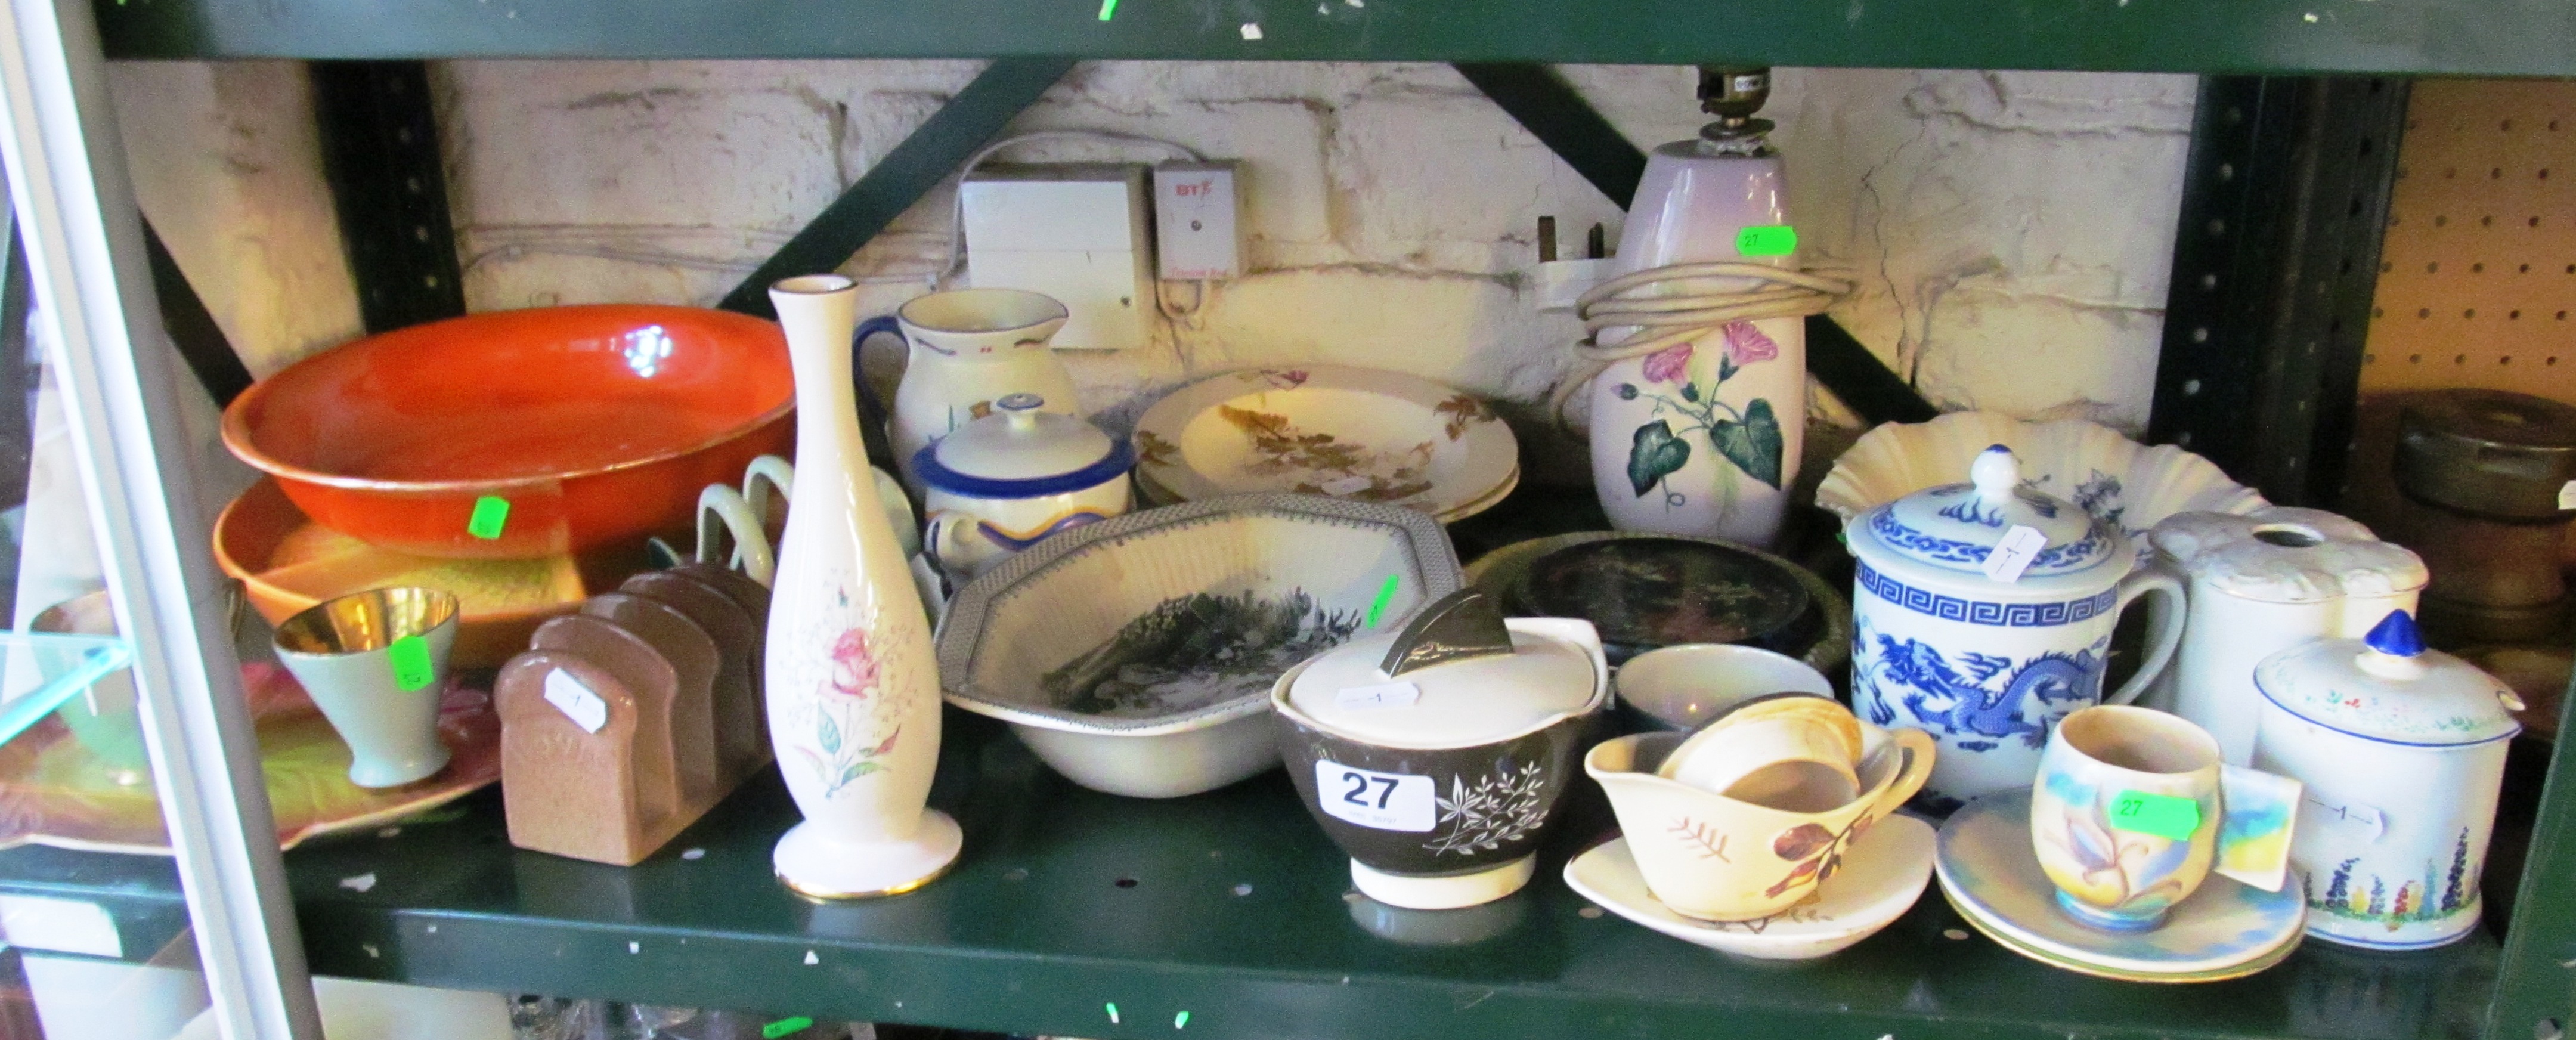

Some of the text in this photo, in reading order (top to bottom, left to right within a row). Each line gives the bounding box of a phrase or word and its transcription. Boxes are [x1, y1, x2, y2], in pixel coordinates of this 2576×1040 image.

[1175, 184, 1197, 196] BT
[1745, 234, 1758, 247] 27
[1342, 772, 1400, 810] 27
[2120, 800, 2144, 816] 27
